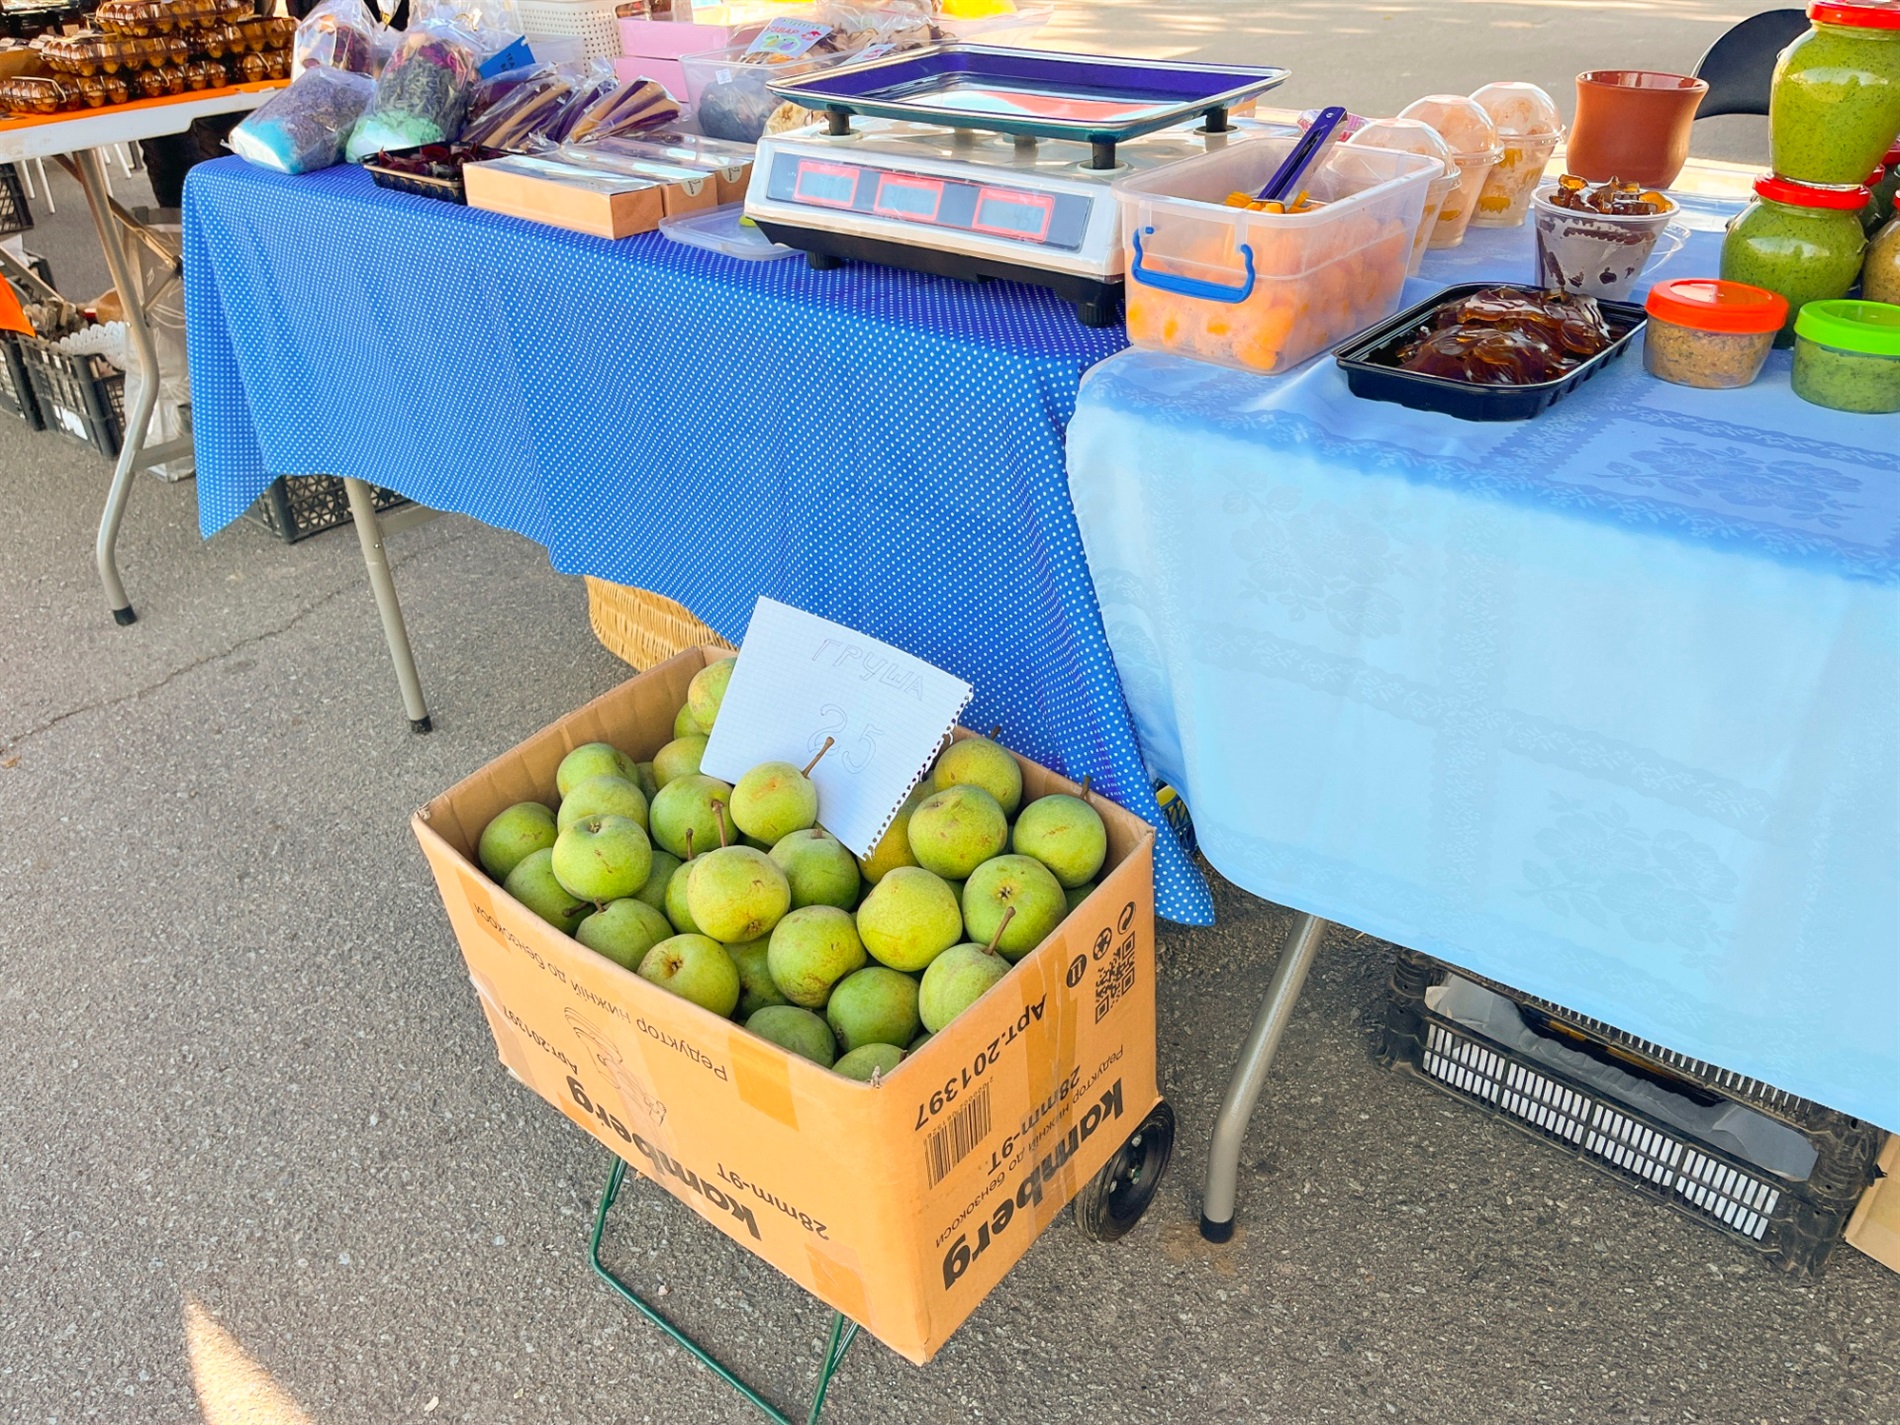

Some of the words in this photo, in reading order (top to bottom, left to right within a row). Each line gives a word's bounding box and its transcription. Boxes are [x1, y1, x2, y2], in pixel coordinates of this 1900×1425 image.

[811, 638, 924, 700] ГРУША
[807, 703, 884, 774] 25
[474, 903, 546, 970] бензокоси
[548, 963, 567, 984] до
[570, 980, 631, 1024] нижній
[636, 1018, 729, 1082] Редуктор
[915, 993, 1048, 1132] Арт.201397
[1072, 1044, 1124, 1104] Редуктор
[986, 1064, 1081, 1176] 28mm-9T
[566, 1075, 762, 1241] kamberg
[942, 1077, 1124, 1291] kamberg
[1008, 1147, 1025, 1172] до
[716, 1162, 830, 1240] 28mm-9T
[935, 1171, 1006, 1248] бензокоси
